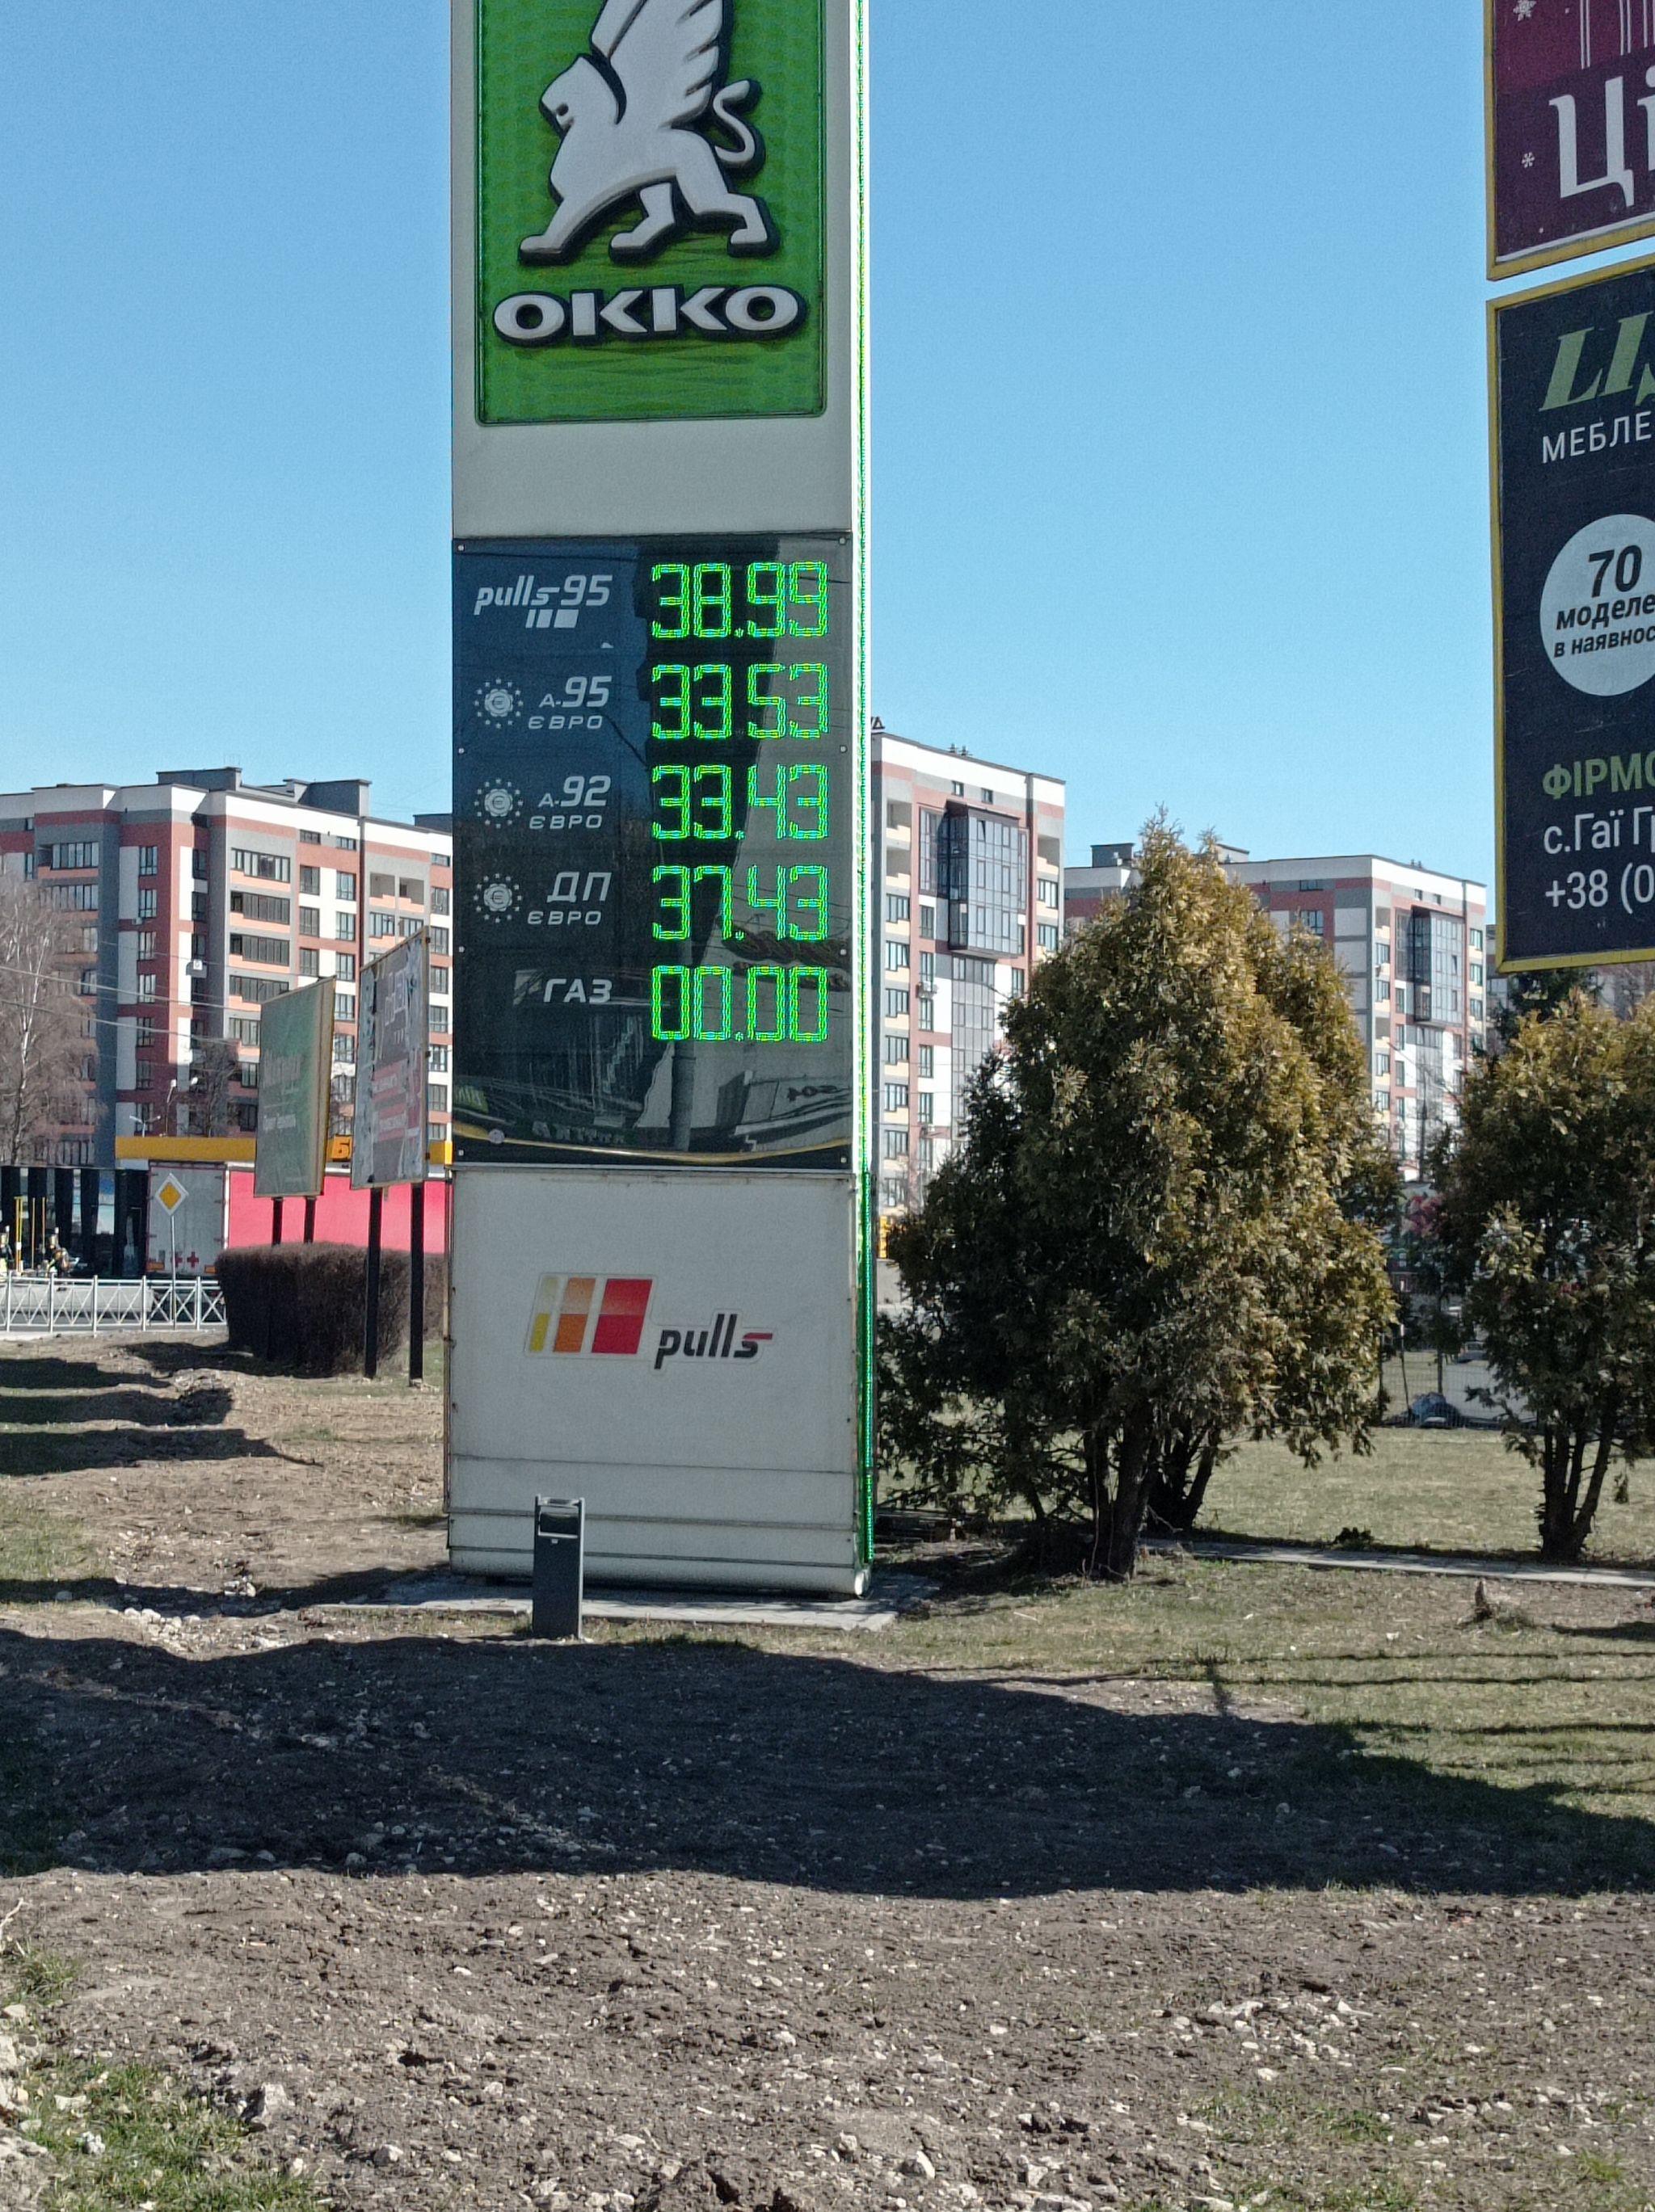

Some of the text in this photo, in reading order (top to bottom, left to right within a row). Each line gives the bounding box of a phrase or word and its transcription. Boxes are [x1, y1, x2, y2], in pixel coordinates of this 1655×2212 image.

[494, 286, 800, 341] OKKO
[1588, 545, 1642, 598] 70
[474, 574, 560, 616] pulls
[652, 561, 828, 638] 38.99
[1556, 594, 1655, 630] моделе
[1554, 625, 1655, 658] в наявнос
[538, 675, 613, 708] А-95
[528, 715, 603, 730] ЄВРО
[538, 776, 611, 807] А-92
[652, 764, 828, 840] 33.43
[529, 814, 602, 830] ЄВРО
[547, 872, 612, 902] ДП
[652, 865, 828, 940] 37.43
[1545, 863, 1655, 914] +38 (0
[527, 910, 601, 925] ЄВРО
[543, 978, 613, 1003] ГАЗ
[652, 965, 828, 1041] 00.00
[654, 1313, 773, 1369] pulls
